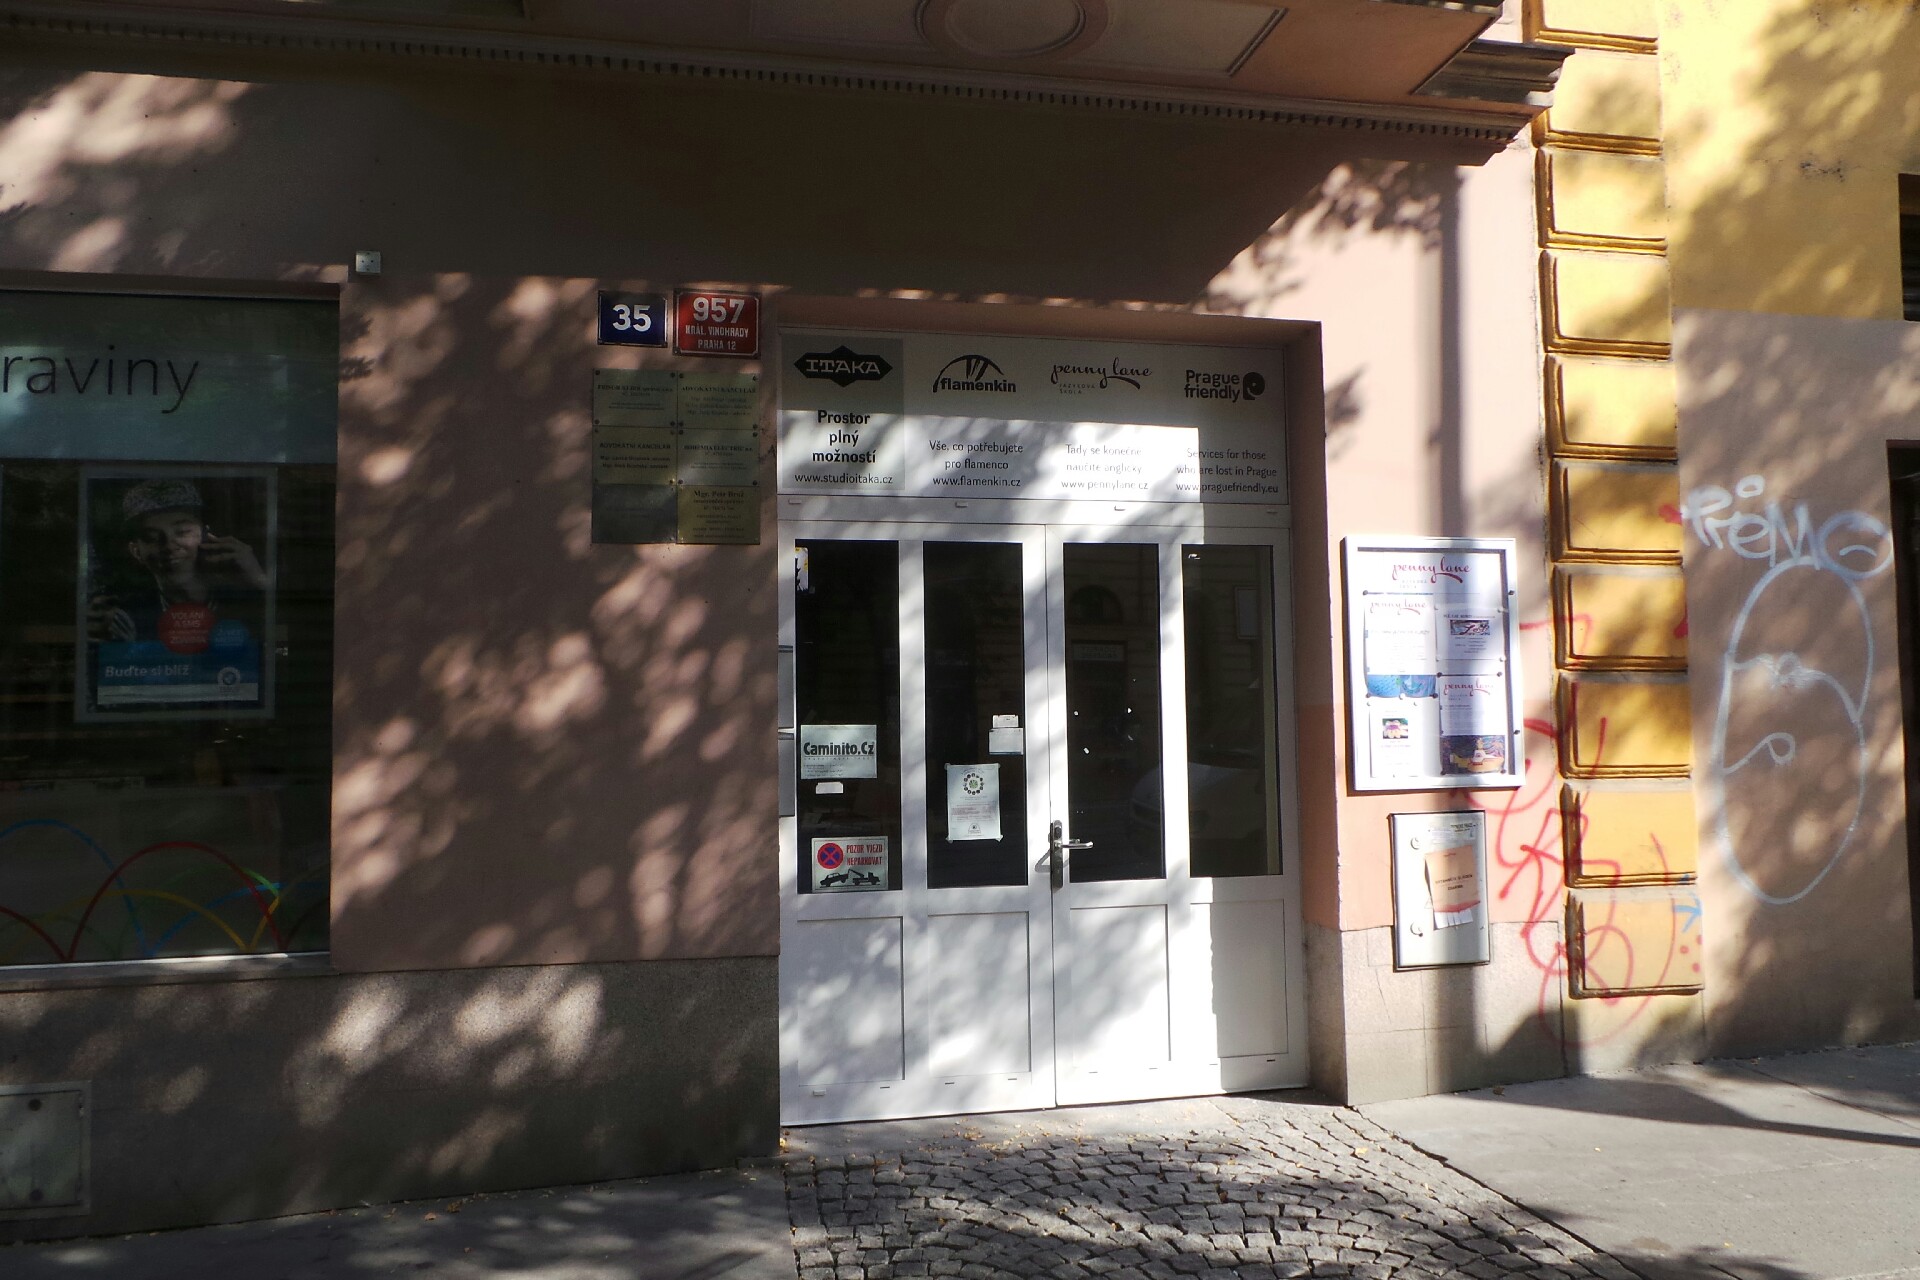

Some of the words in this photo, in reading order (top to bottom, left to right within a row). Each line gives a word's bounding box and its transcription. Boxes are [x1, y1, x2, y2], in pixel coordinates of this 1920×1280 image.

[693, 297, 745, 324] 957
[612, 303, 652, 333] 35
[685, 324, 706, 336] KRÁL.
[708, 326, 749, 338] VINOHRADY
[697, 339, 724, 350] PRAHA
[726, 340, 737, 350] 12
[805, 359, 881, 375] ITAKA
[1050, 364, 1108, 389] penny
[1112, 356, 1153, 378] lane
[1, 345, 200, 415] raviny
[939, 378, 1017, 393] flamenkin
[1185, 369, 1240, 388] Prague
[1184, 385, 1240, 403] friendly
[817, 410, 871, 425] Prostor
[829, 430, 859, 447] plný
[952, 444, 964, 452] co
[967, 441, 1024, 454] potřebujete
[1065, 443, 1088, 456] Tady
[1090, 446, 1101, 455] se
[1186, 448, 1224, 459] Services
[1226, 449, 1239, 459] for
[1242, 449, 1267, 460] those
[812, 449, 877, 464] možností
[944, 460, 961, 470] pro
[964, 459, 1009, 470] flamenco
[1104, 462, 1143, 474] anglicky
[794, 472, 893, 484] www.studioitaka.cz
[1176, 465, 1196, 475] who
[1199, 466, 1214, 475] are
[1215, 465, 1233, 476] lost
[1235, 466, 1244, 476] in
[1246, 466, 1278, 479] Prague
[932, 475, 1021, 487] www.flamenkin.cz
[1176, 482, 1279, 494] www.praguefriendly.eu
[1391, 562, 1436, 584] penny
[1440, 556, 1472, 574] lane
[1404, 598, 1426, 609] lane
[104, 665, 148, 678] Buďte
[151, 666, 161, 677] si
[166, 664, 191, 676] blíž
[1444, 683, 1474, 697] penny
[803, 741, 875, 756] Caminito.Cz
[846, 844, 865, 853] POZOR
[866, 843, 883, 853] VJEZD
[846, 856, 883, 866] NEPARKOVAT
